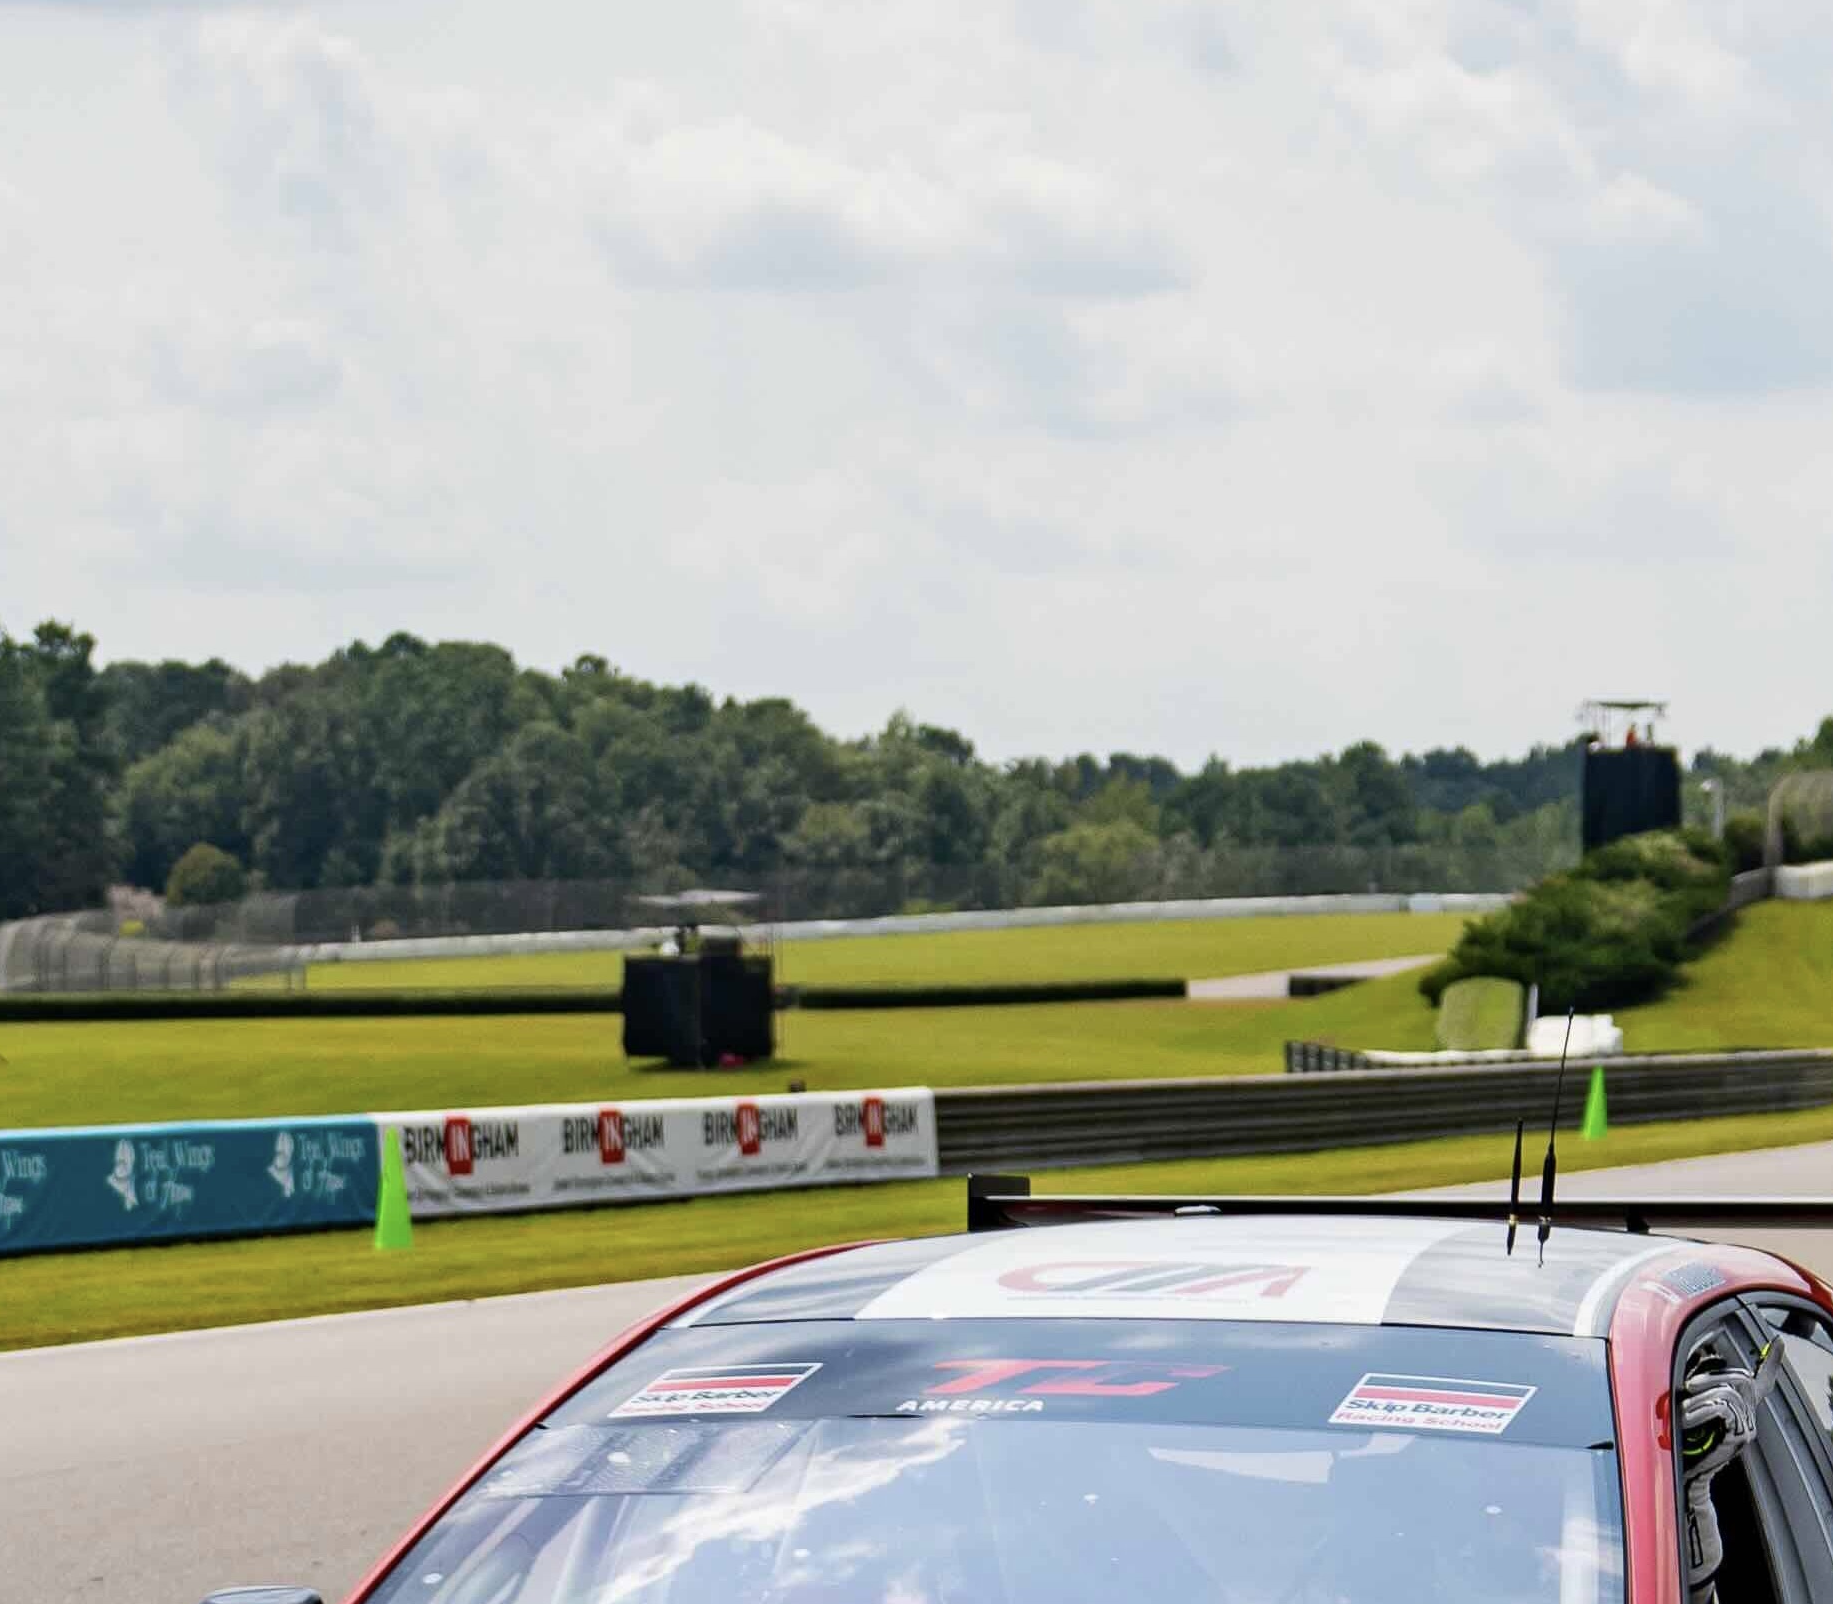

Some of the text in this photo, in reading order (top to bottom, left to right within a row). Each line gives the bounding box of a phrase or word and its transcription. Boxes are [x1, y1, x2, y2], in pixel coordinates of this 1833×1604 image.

[563, 1114, 665, 1154] BIRMINGHAM
[703, 1107, 797, 1146] BIRMINGHAM
[834, 1100, 918, 1136] BIRMINGHAM
[403, 1120, 519, 1164] BIRMINGHAM
[2, 1150, 46, 1183] Wings
[925, 1358, 1232, 1395] TC
[896, 1399, 1045, 1413] AMERICA
[1335, 1411, 1504, 1430] Racing School
[1346, 1398, 1513, 1420] Skip Barber
